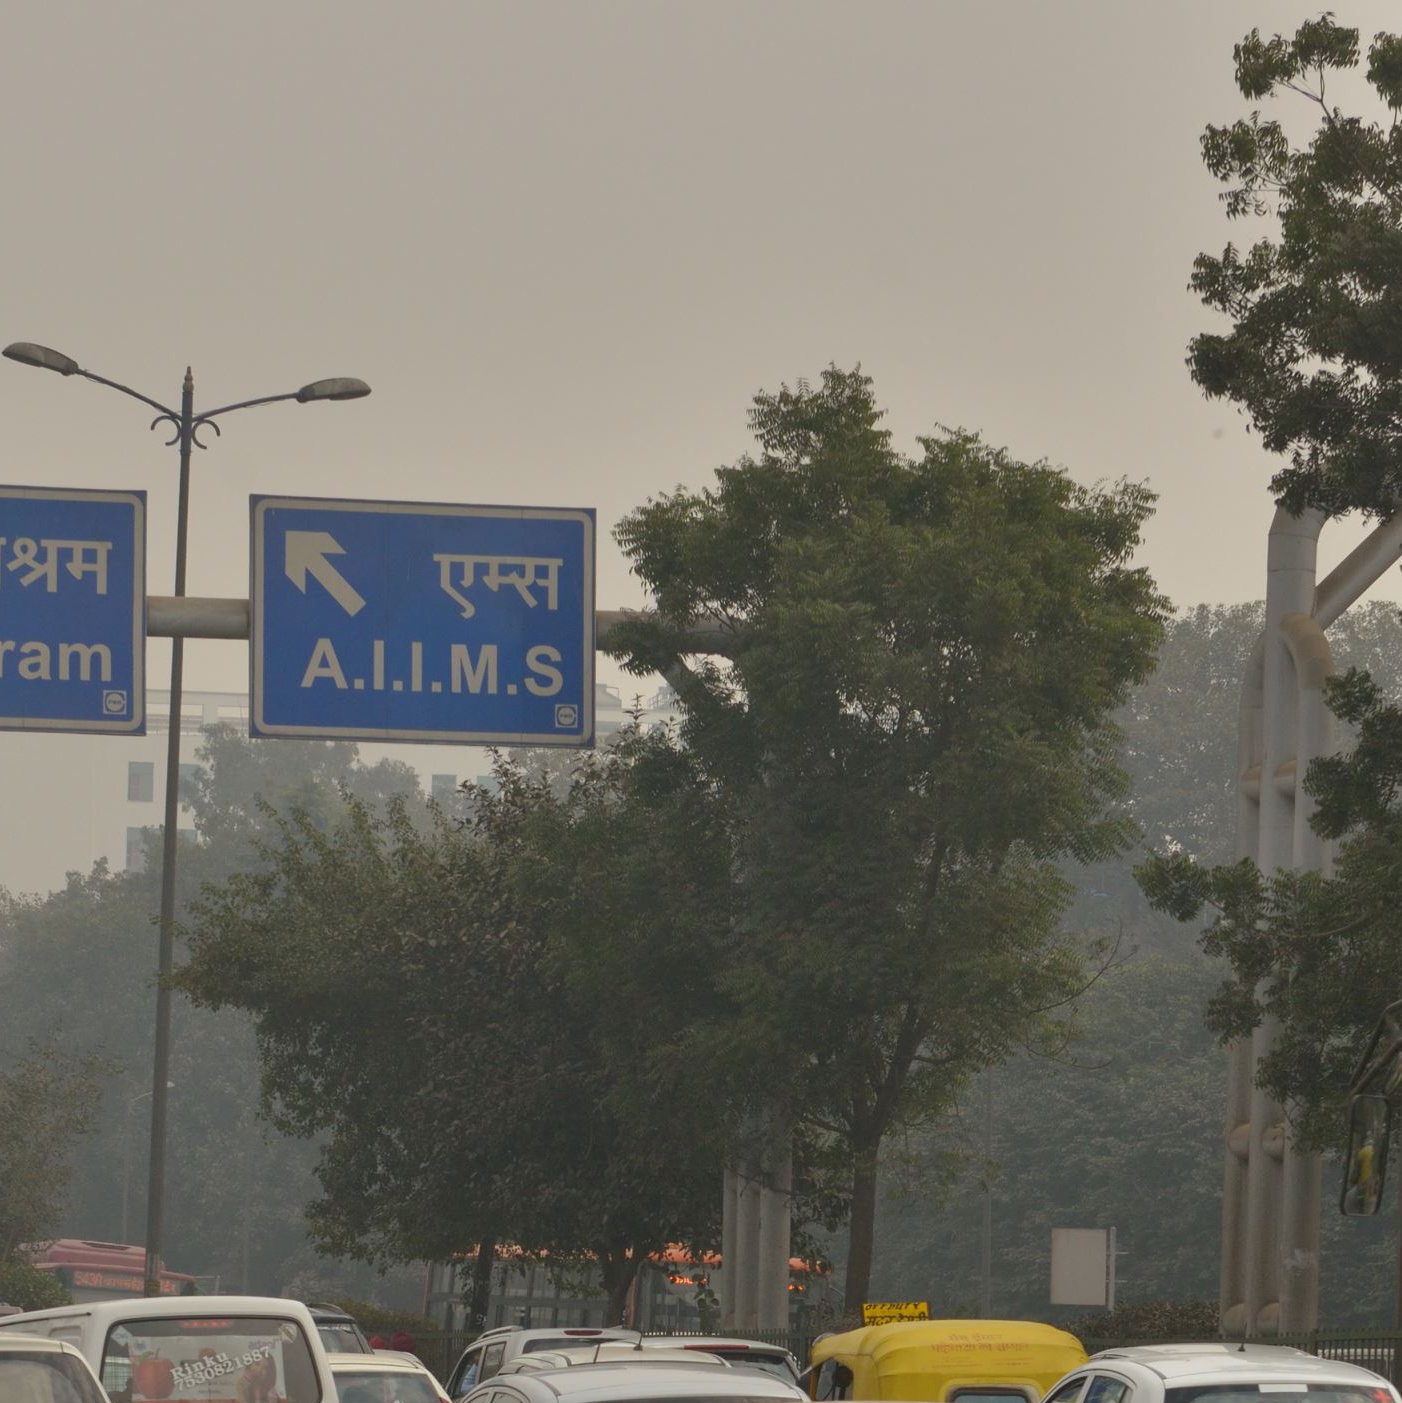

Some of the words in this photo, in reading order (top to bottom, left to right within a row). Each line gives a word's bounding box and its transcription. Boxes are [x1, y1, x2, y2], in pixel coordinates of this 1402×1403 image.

[432, 553, 564, 619] एम्स
[300, 637, 564, 697] A.I.I.M.S
[170, 1351, 230, 1381] Rinku
